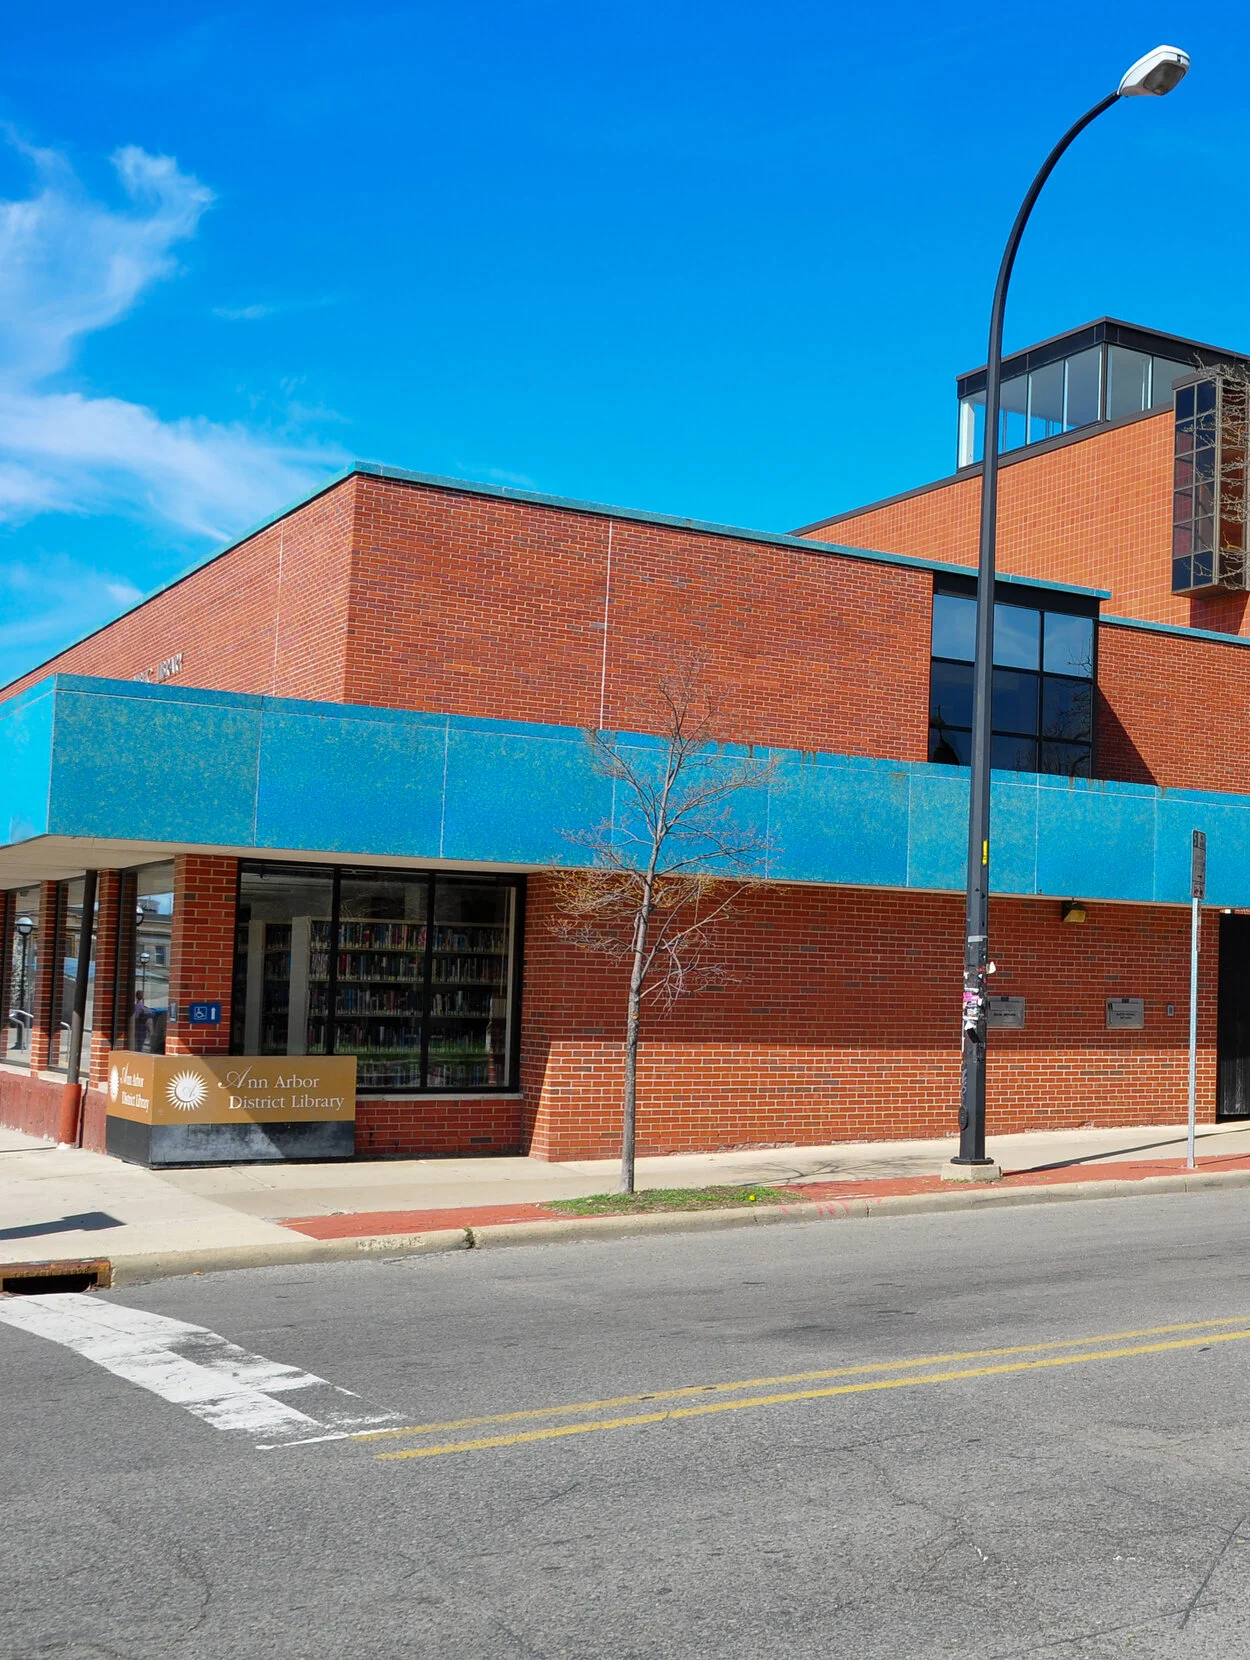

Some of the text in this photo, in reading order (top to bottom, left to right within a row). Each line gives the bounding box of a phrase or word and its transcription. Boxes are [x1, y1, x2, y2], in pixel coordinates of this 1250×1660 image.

[217, 1065, 320, 1089] Ann Arbor
[229, 1095, 345, 1111] District Library
